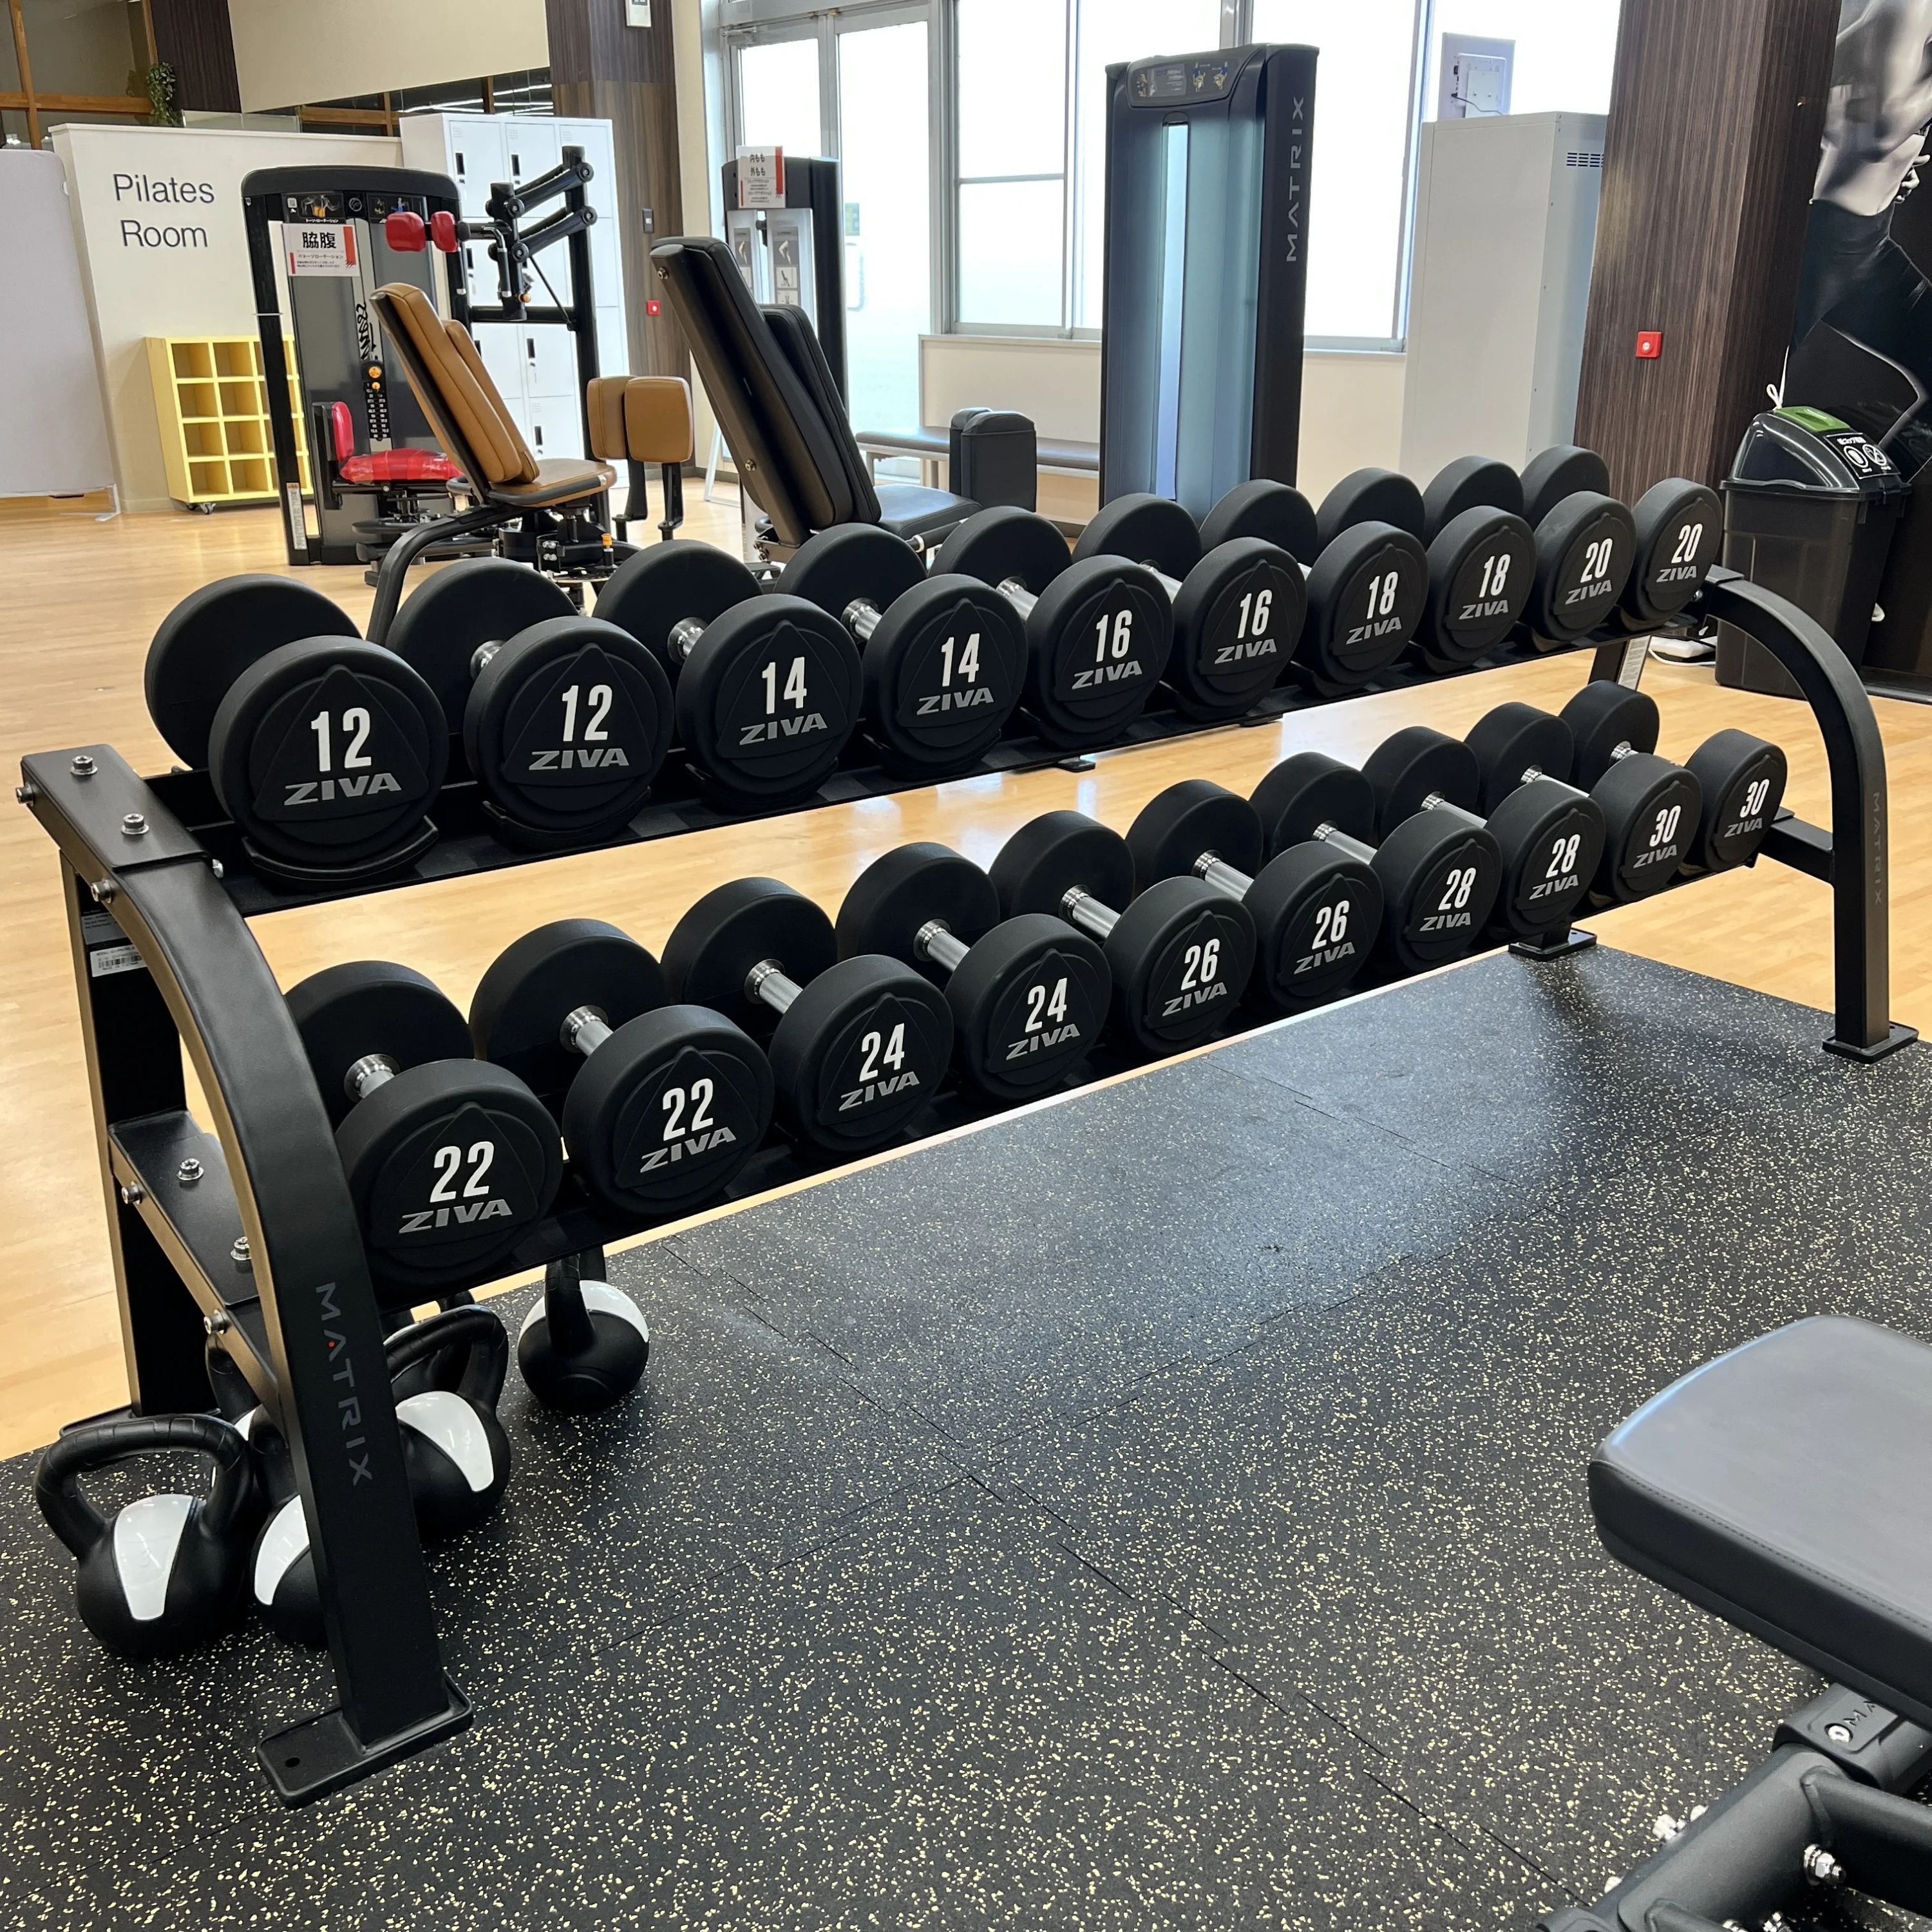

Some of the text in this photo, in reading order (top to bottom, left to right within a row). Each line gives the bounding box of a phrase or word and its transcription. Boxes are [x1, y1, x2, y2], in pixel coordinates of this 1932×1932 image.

[113, 173, 215, 204] Pilates
[1286, 96, 1304, 261] MATRIX
[120, 219, 208, 248] Room
[301, 231, 337, 249] 脇腹
[1580, 538, 1613, 583] 20
[1672, 523, 1703, 564] 20
[1479, 553, 1511, 598] 18
[1566, 580, 1611, 605] ZIVA
[1656, 566, 1698, 582] ZIVA
[1237, 589, 1273, 639] 16
[1366, 571, 1399, 619] 18
[1459, 600, 1508, 620] ZIVA
[1095, 609, 1133, 662] 16
[1347, 617, 1401, 644] ZIVA
[941, 632, 980, 687] 14
[1215, 639, 1276, 664] ZIVA
[762, 656, 808, 714] 14
[1072, 661, 1142, 689] ZIVA
[562, 684, 613, 741] 12
[917, 688, 994, 715] ZIVA
[310, 707, 372, 772] 12
[740, 714, 827, 744] ZIVA
[529, 748, 629, 770] ZIVA
[285, 773, 401, 805] ZIVA
[1739, 778, 1770, 818] 30
[1649, 804, 1681, 847] 30
[1725, 818, 1761, 837] ZIVA
[1545, 833, 1581, 878] 28
[1634, 845, 1676, 868] ZIVA
[1873, 791, 1882, 905] MATRIX
[1437, 867, 1477, 910] 28
[1530, 875, 1578, 899] ZIVA
[1311, 900, 1350, 949] 26
[1420, 913, 1470, 931] ZIVA
[1180, 938, 1220, 990] 26
[1294, 942, 1354, 974] ZIVA
[1025, 977, 1068, 1032] 24
[1162, 983, 1227, 1016] ZIVA
[858, 1022, 905, 1082] 24
[1007, 1024, 1080, 1060] ZIVA
[662, 1077, 714, 1141] 22
[839, 1072, 919, 1111] ZIVA
[640, 1127, 736, 1173] ZIVA
[429, 1141, 495, 1203] 22
[399, 1199, 512, 1233] ZIVA
[316, 1282, 373, 1486] MATRIX
